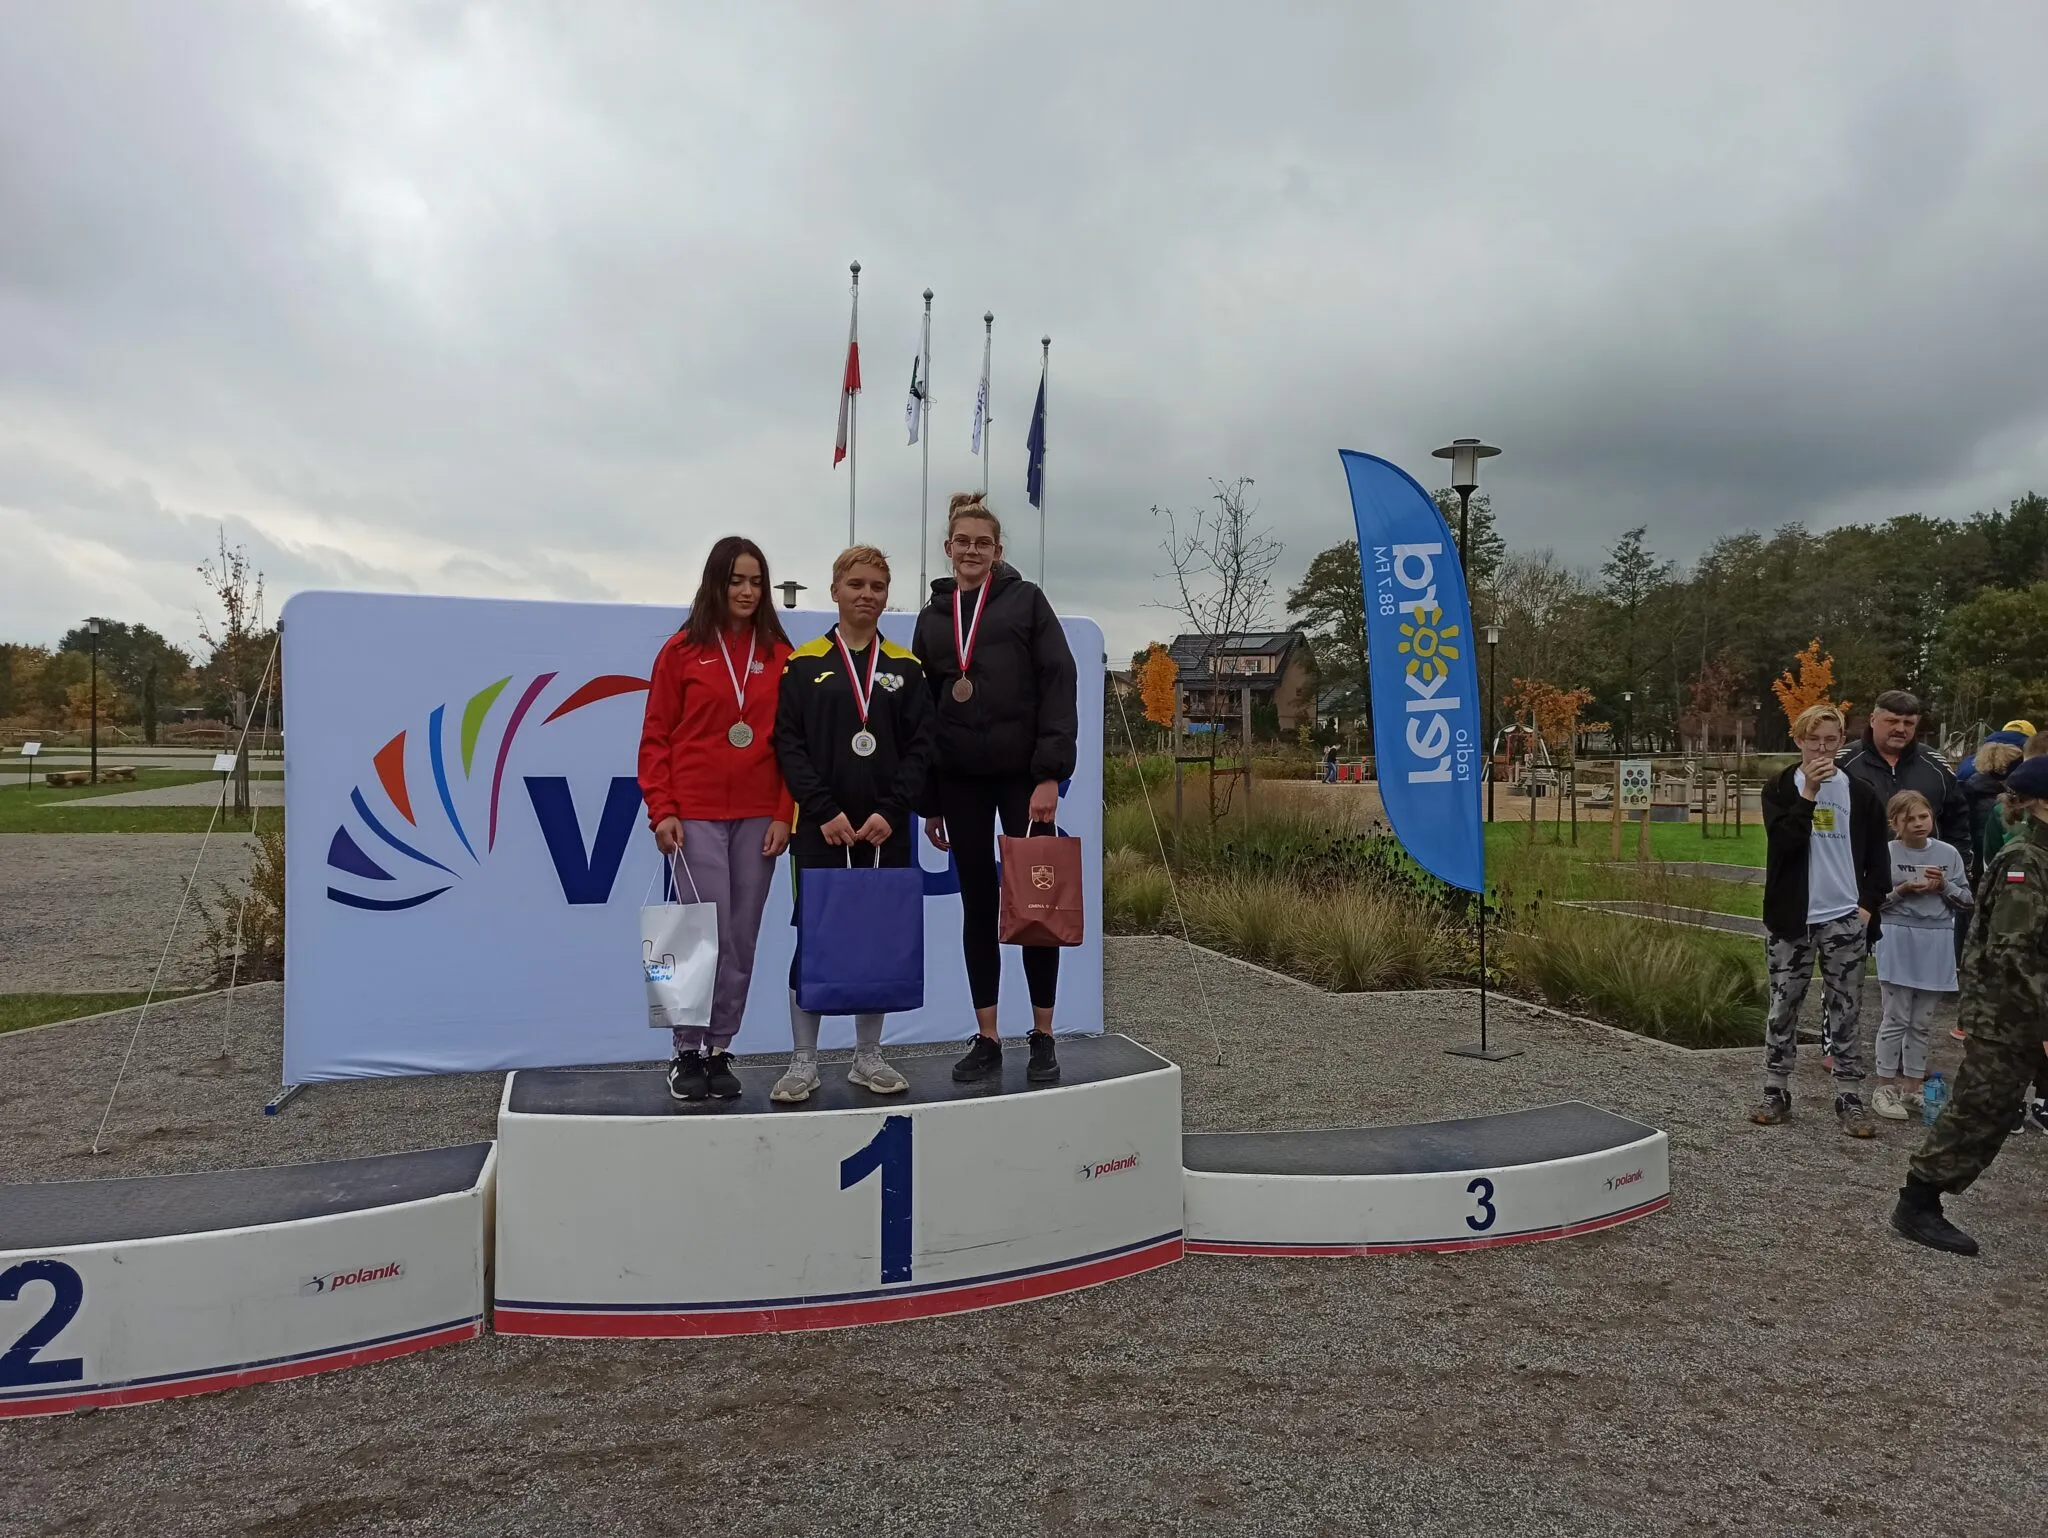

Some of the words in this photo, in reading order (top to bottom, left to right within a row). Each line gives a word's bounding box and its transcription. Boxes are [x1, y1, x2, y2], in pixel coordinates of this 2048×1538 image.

[1094, 1154, 1137, 1179] polanik
[1614, 1169, 1643, 1190] polanik
[840, 1115, 913, 1284] 1
[1465, 1177, 1497, 1231] 3
[330, 1262, 401, 1292] polanik
[0, 1259, 84, 1388] 2
